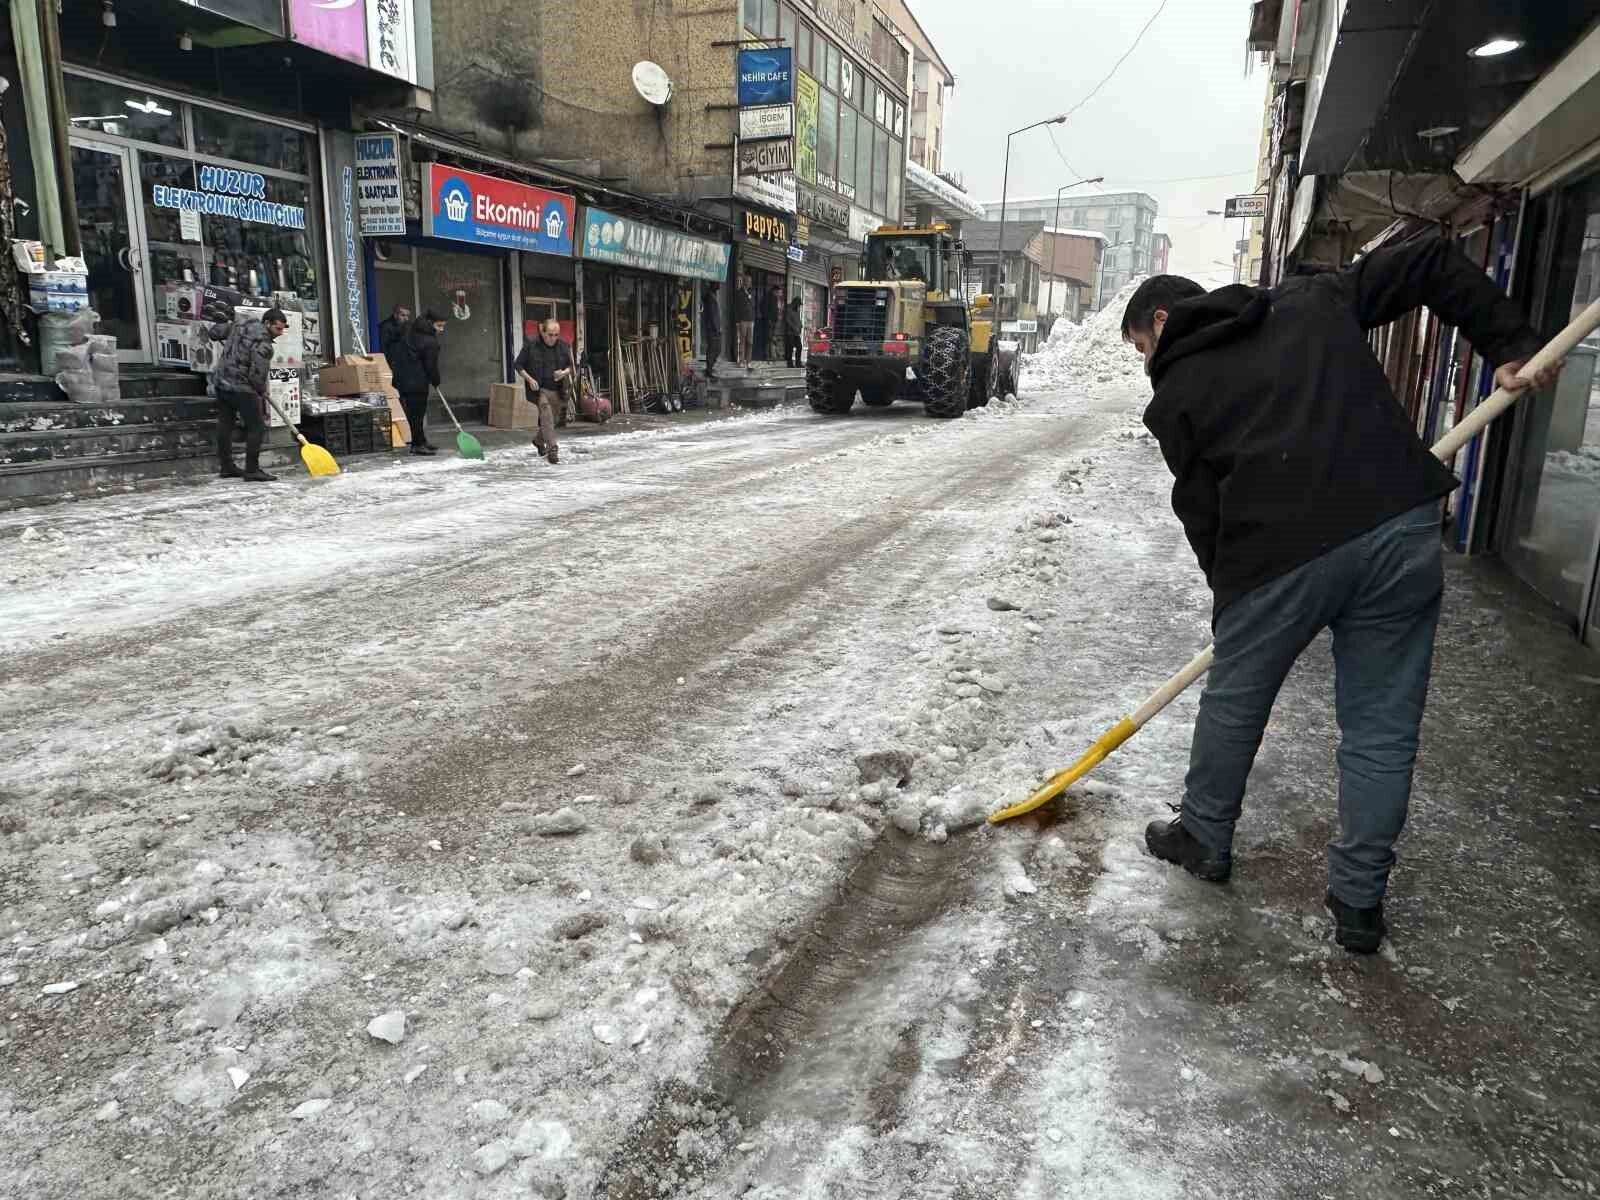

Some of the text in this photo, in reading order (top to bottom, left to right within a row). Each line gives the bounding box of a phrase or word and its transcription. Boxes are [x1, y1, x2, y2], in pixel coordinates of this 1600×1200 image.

[741, 71, 788, 82] NEHİR CAFE
[200, 165, 266, 200] HUZUR
[475, 193, 541, 230] Ekomini
